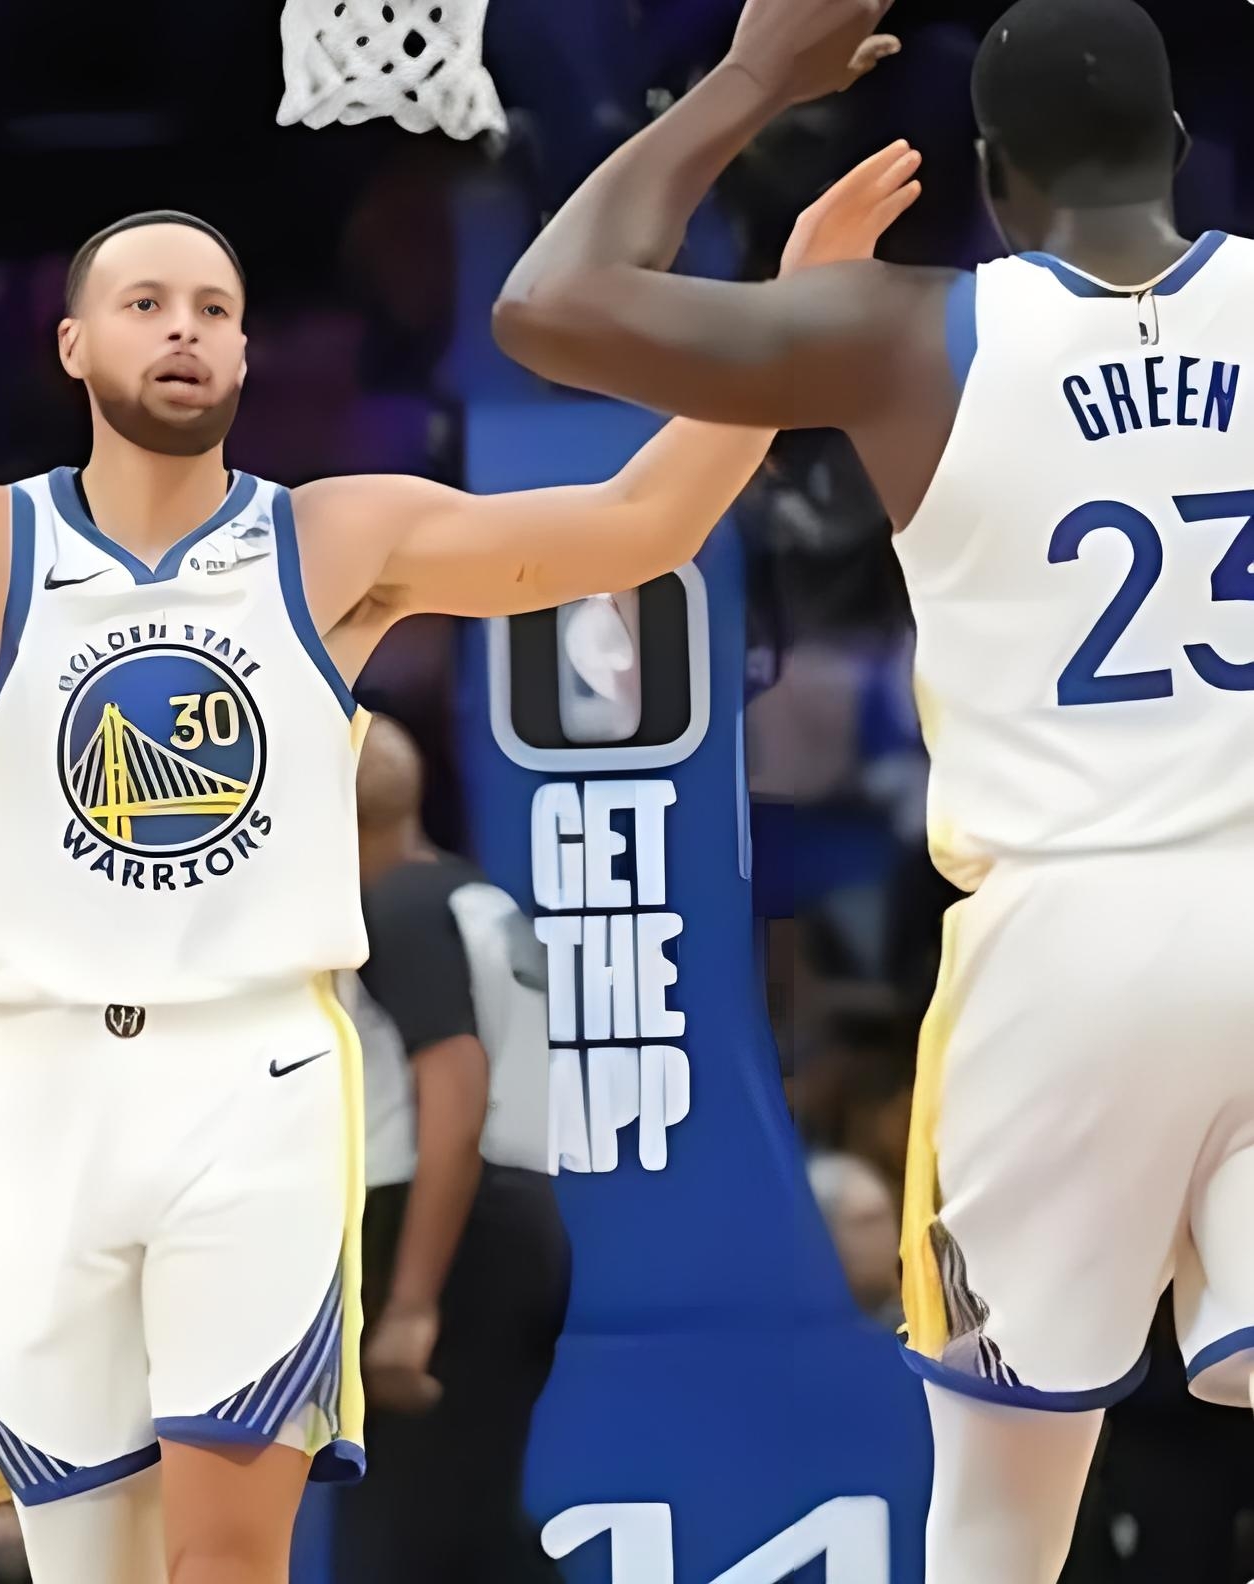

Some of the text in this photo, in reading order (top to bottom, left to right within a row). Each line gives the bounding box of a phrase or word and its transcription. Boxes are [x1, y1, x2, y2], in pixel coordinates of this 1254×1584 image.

[1062, 355, 1241, 442] GREEN
[1047, 489, 1254, 707] 23
[169, 691, 241, 751] 30
[62, 808, 273, 891] WARRIORS
[531, 779, 677, 911] GET
[534, 912, 686, 1042] THE
